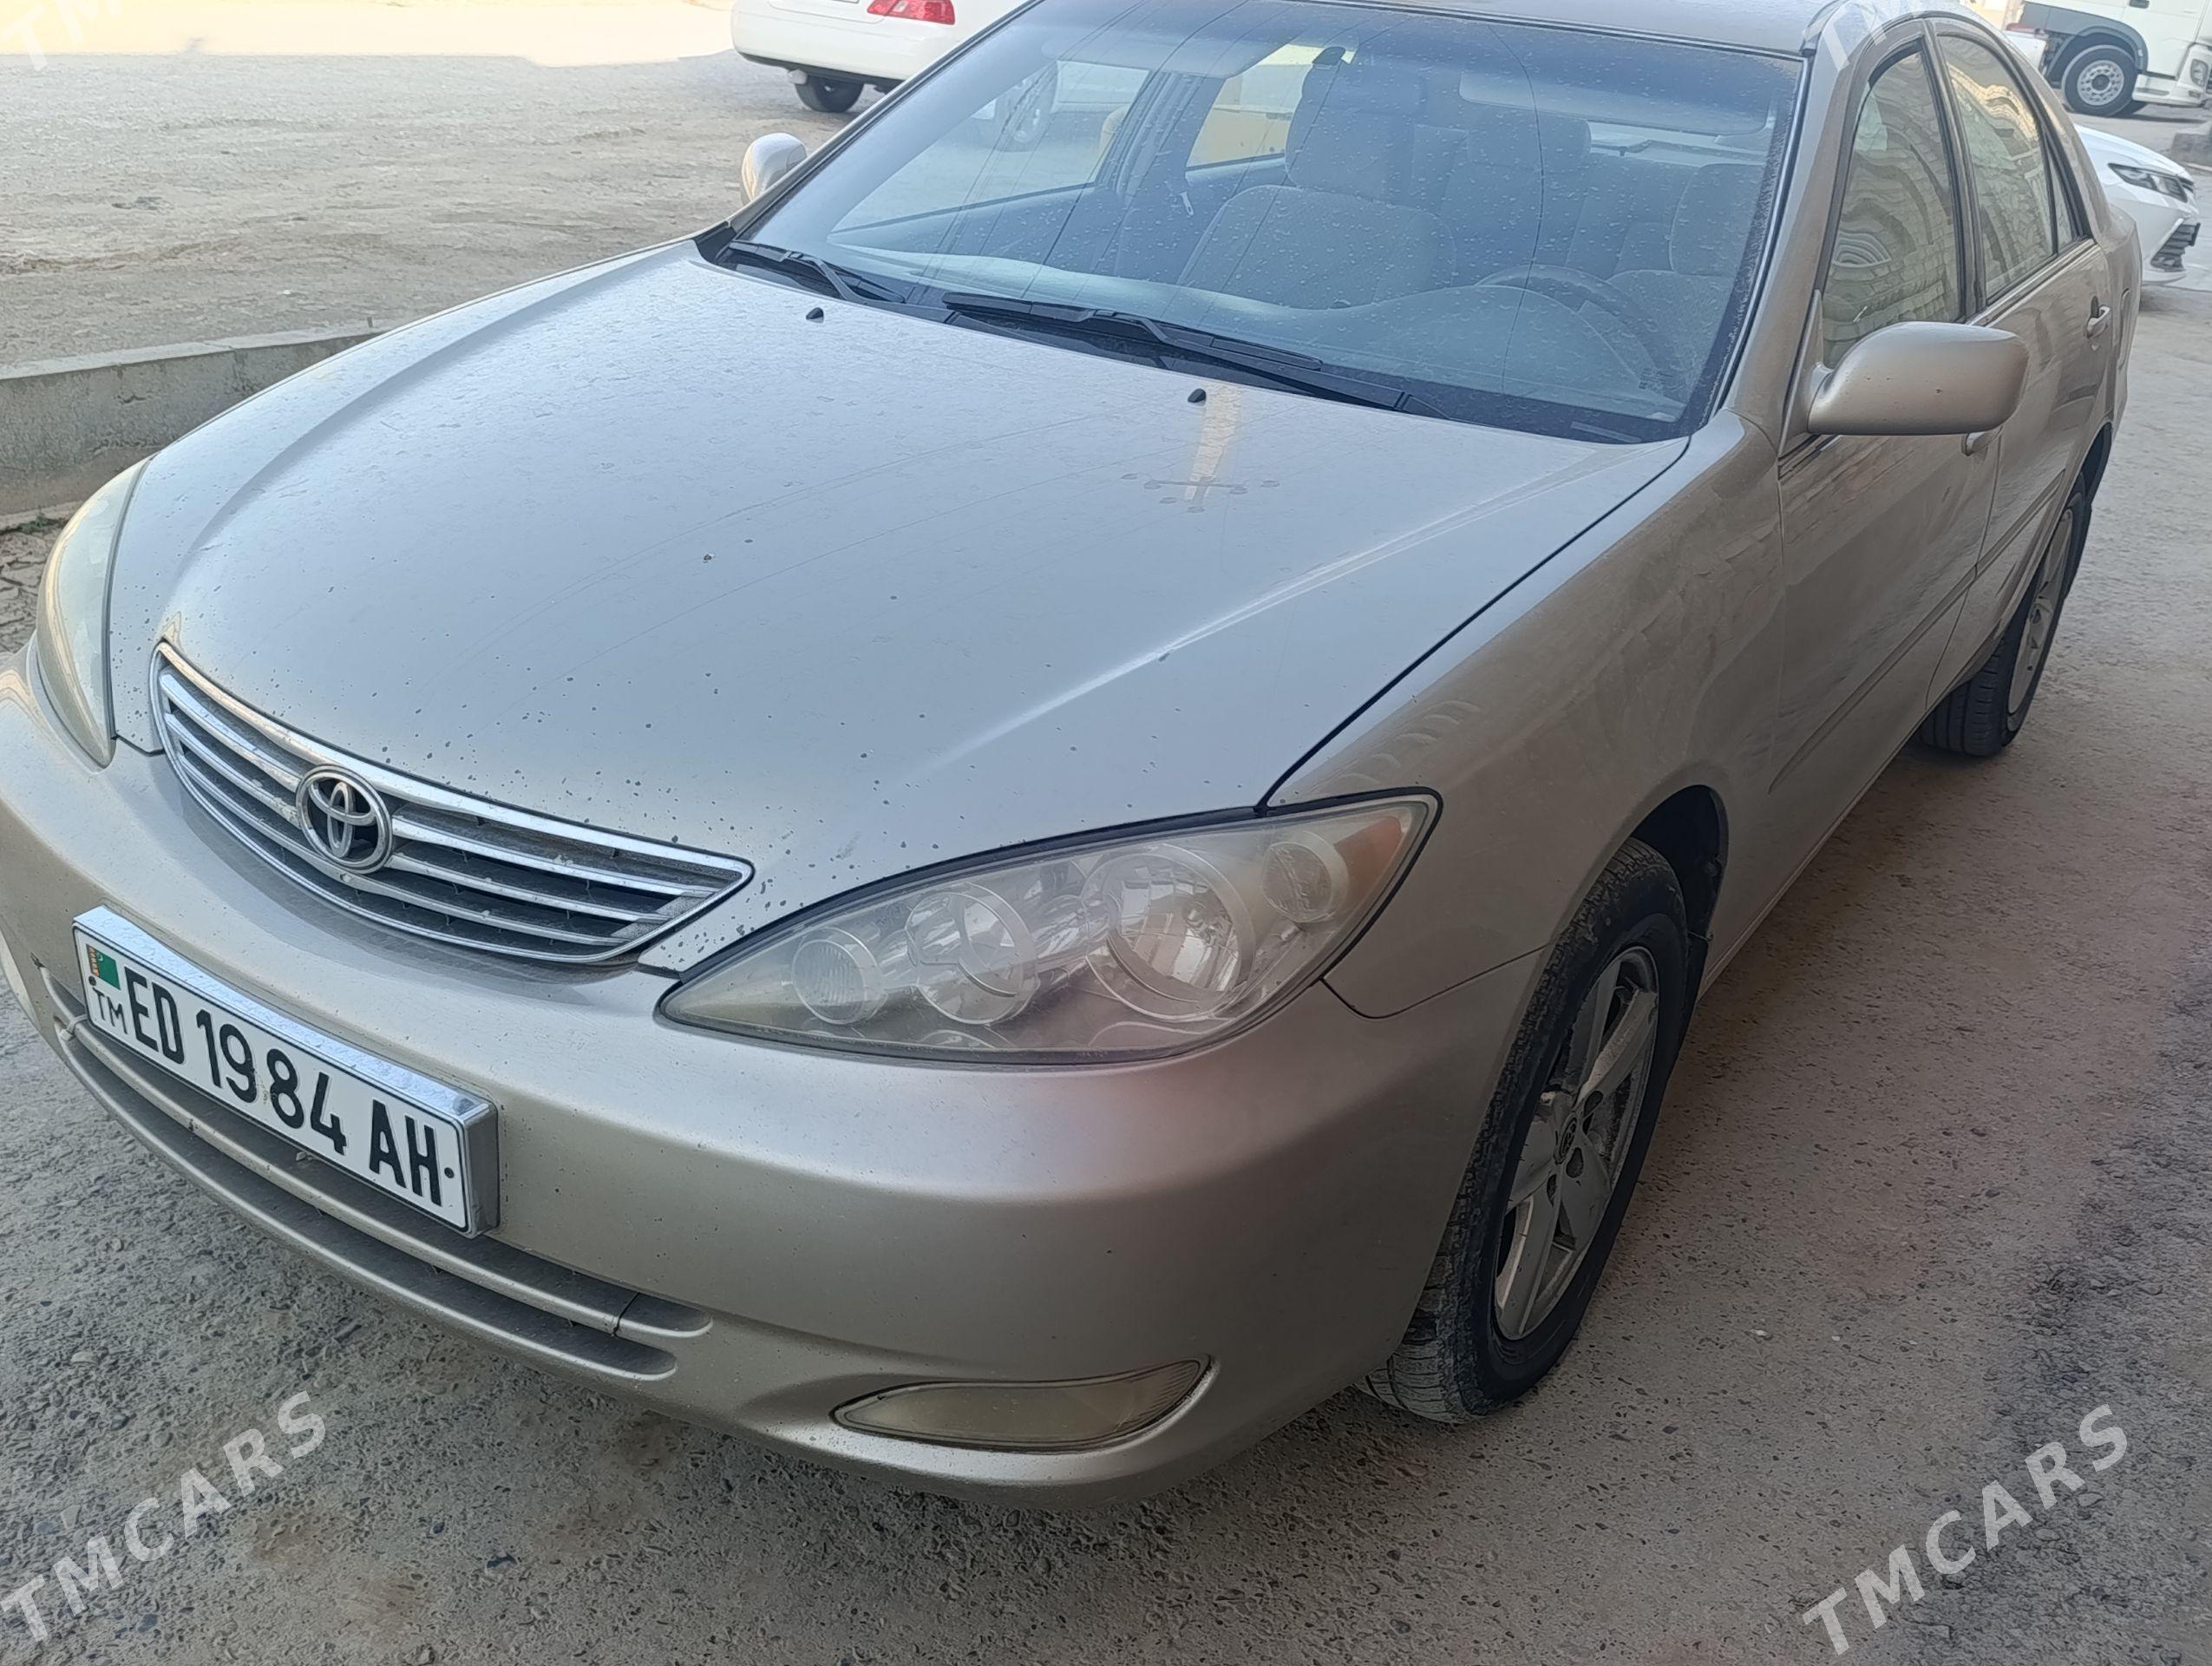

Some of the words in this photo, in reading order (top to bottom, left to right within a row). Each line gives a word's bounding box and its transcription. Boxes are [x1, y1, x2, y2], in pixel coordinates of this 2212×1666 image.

[92, 986, 128, 1035] TM
[124, 965, 185, 1065] ED
[196, 1008, 347, 1156] 1984
[369, 1099, 442, 1207] AH
